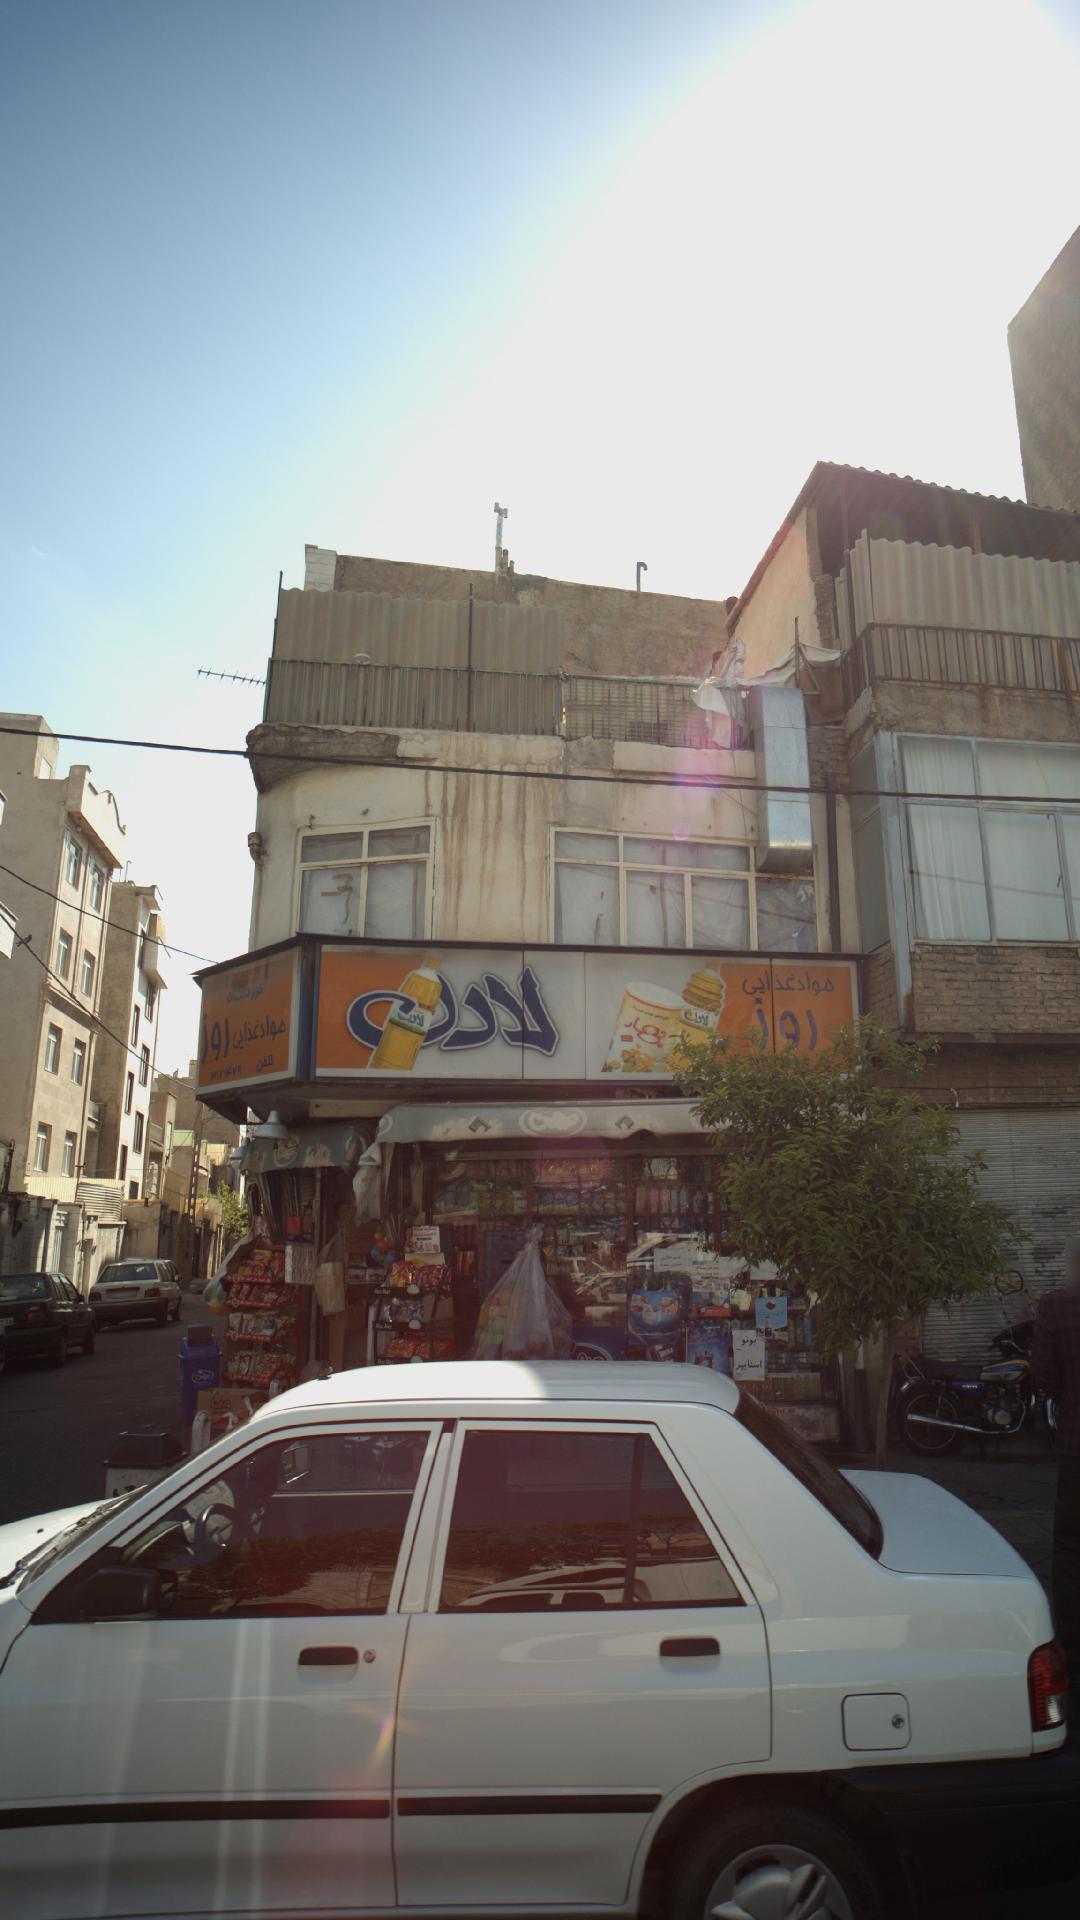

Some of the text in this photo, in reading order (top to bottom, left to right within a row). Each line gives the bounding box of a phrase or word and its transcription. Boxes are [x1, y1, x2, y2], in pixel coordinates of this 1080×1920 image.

[201, 1013, 231, 1066] روز
[347, 967, 558, 1055] لادن
[754, 996, 818, 1053] روز
